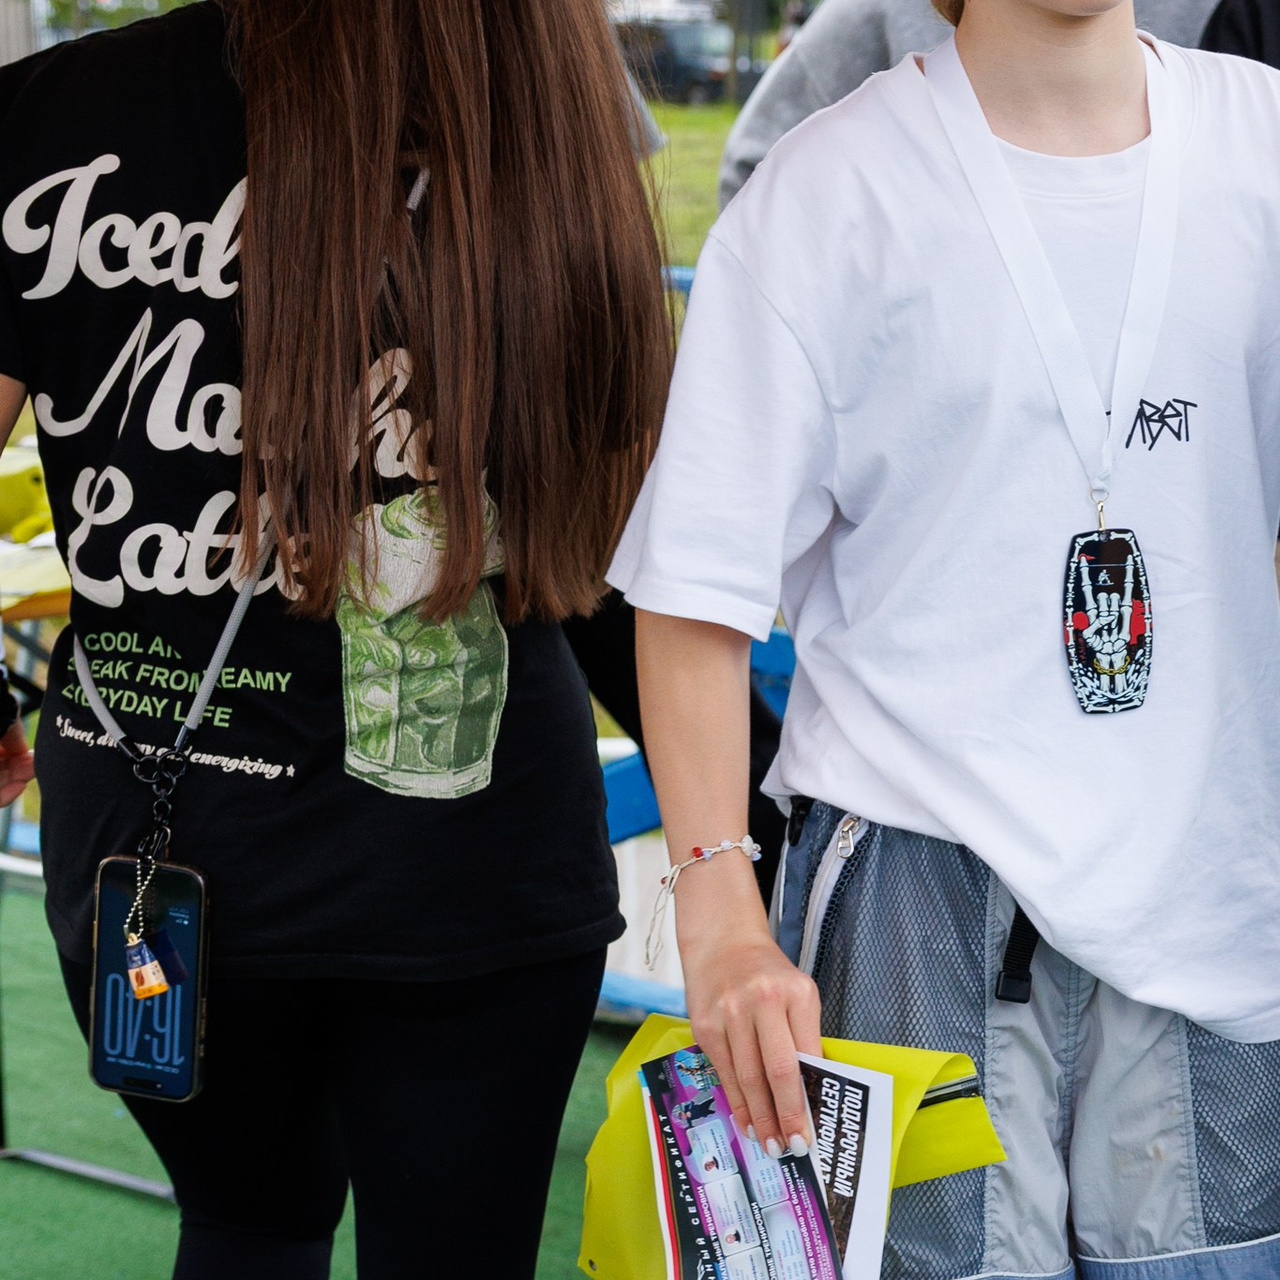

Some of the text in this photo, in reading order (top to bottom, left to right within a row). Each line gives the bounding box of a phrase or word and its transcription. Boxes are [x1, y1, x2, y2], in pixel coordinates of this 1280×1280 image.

[2, 154, 246, 299] Iced
[34, 306, 440, 482] Maha
[67, 656, 133, 680] EAK
[84, 631, 143, 653] COOL
[215, 667, 292, 692] EAMY
[174, 701, 233, 728] LFE
[190, 751, 283, 780] energizing
[833, 1085, 863, 1198] ПОДАРОЧНЫЙ
[658, 1114, 701, 1226] СЕРТИФИКАТ
[696, 1184, 717, 1239] ТРЕНИРОВКИ
[750, 1200, 772, 1257] ТРЕНИРОВКИ
